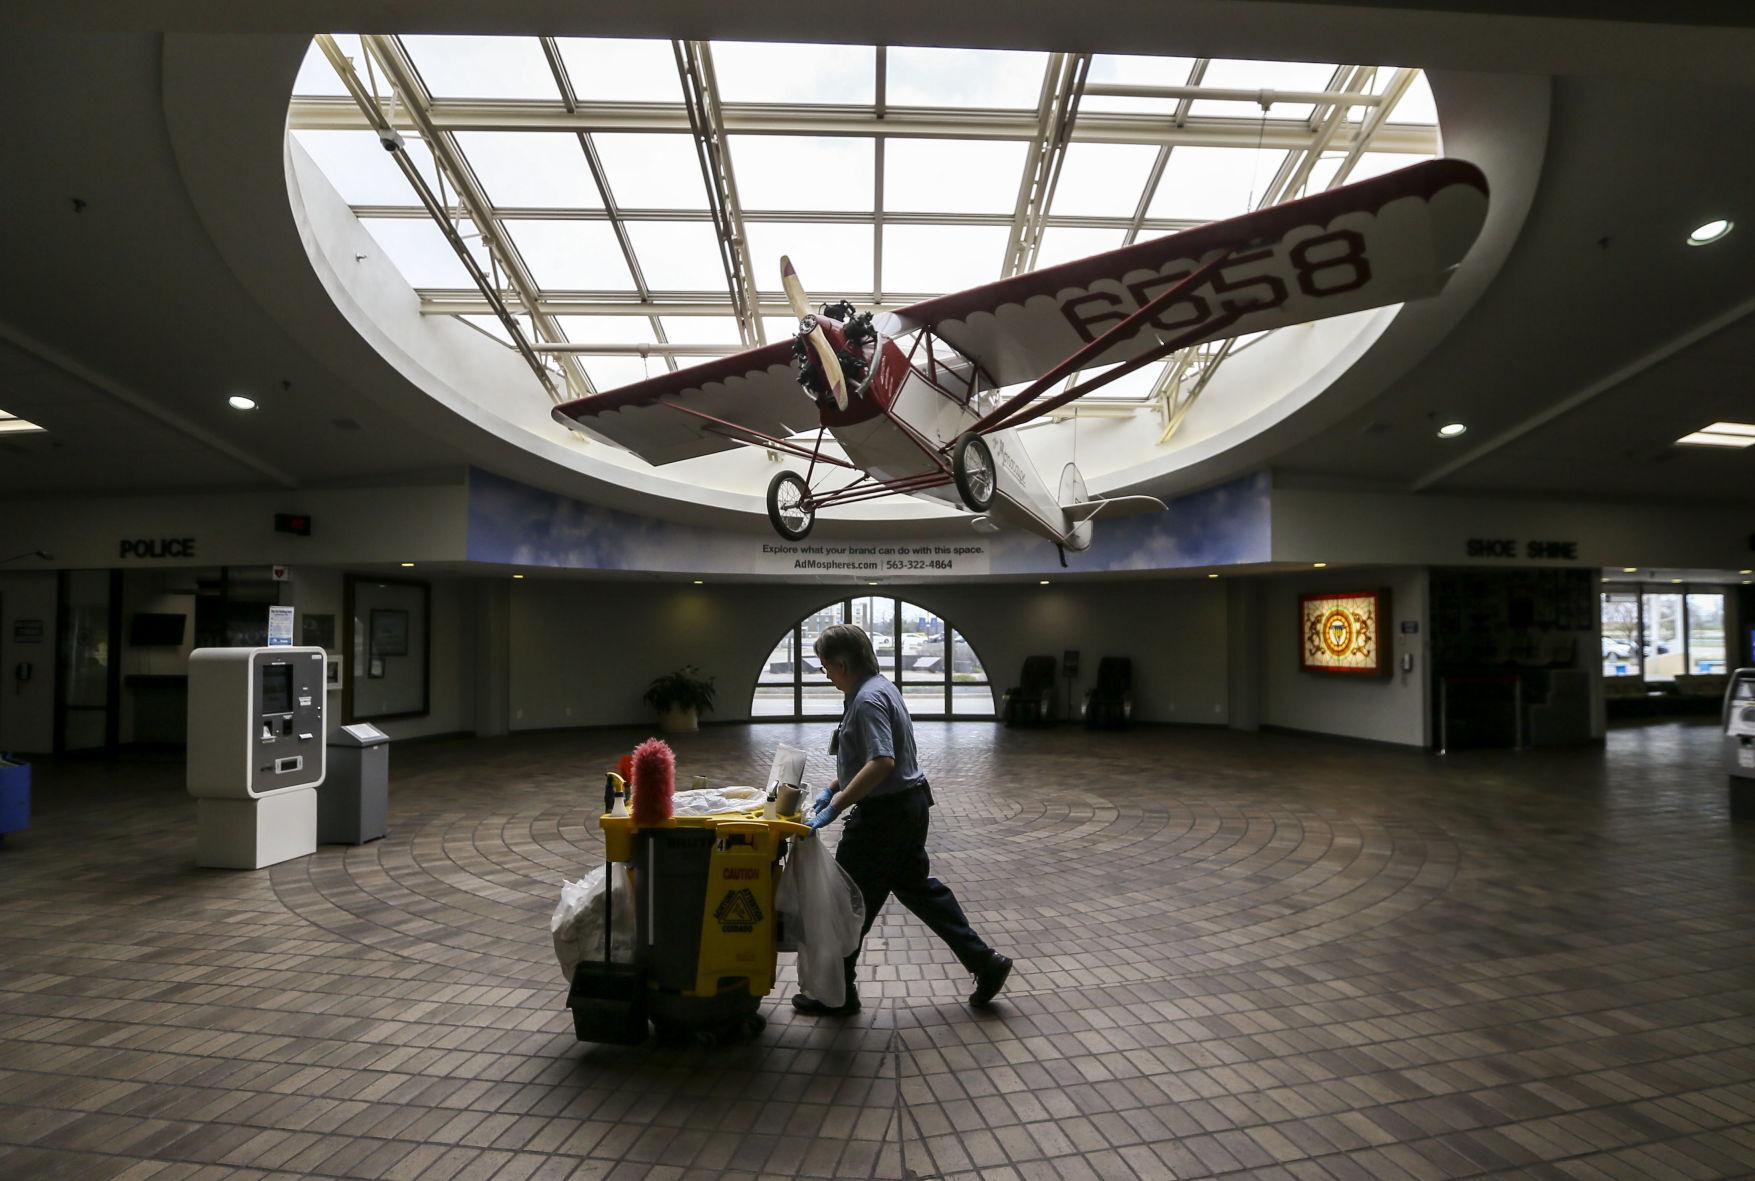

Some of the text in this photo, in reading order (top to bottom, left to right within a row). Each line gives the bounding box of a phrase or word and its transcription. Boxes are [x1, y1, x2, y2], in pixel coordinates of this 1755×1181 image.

[120, 539, 195, 559] POLICE
[762, 544, 984, 557] Explore what your brand can do with this space.
[1466, 538, 1578, 560] SHOE SHINE
[794, 559, 953, 570] AdMospheres.com 563-322-4864
[723, 867, 760, 880] CAUTION
